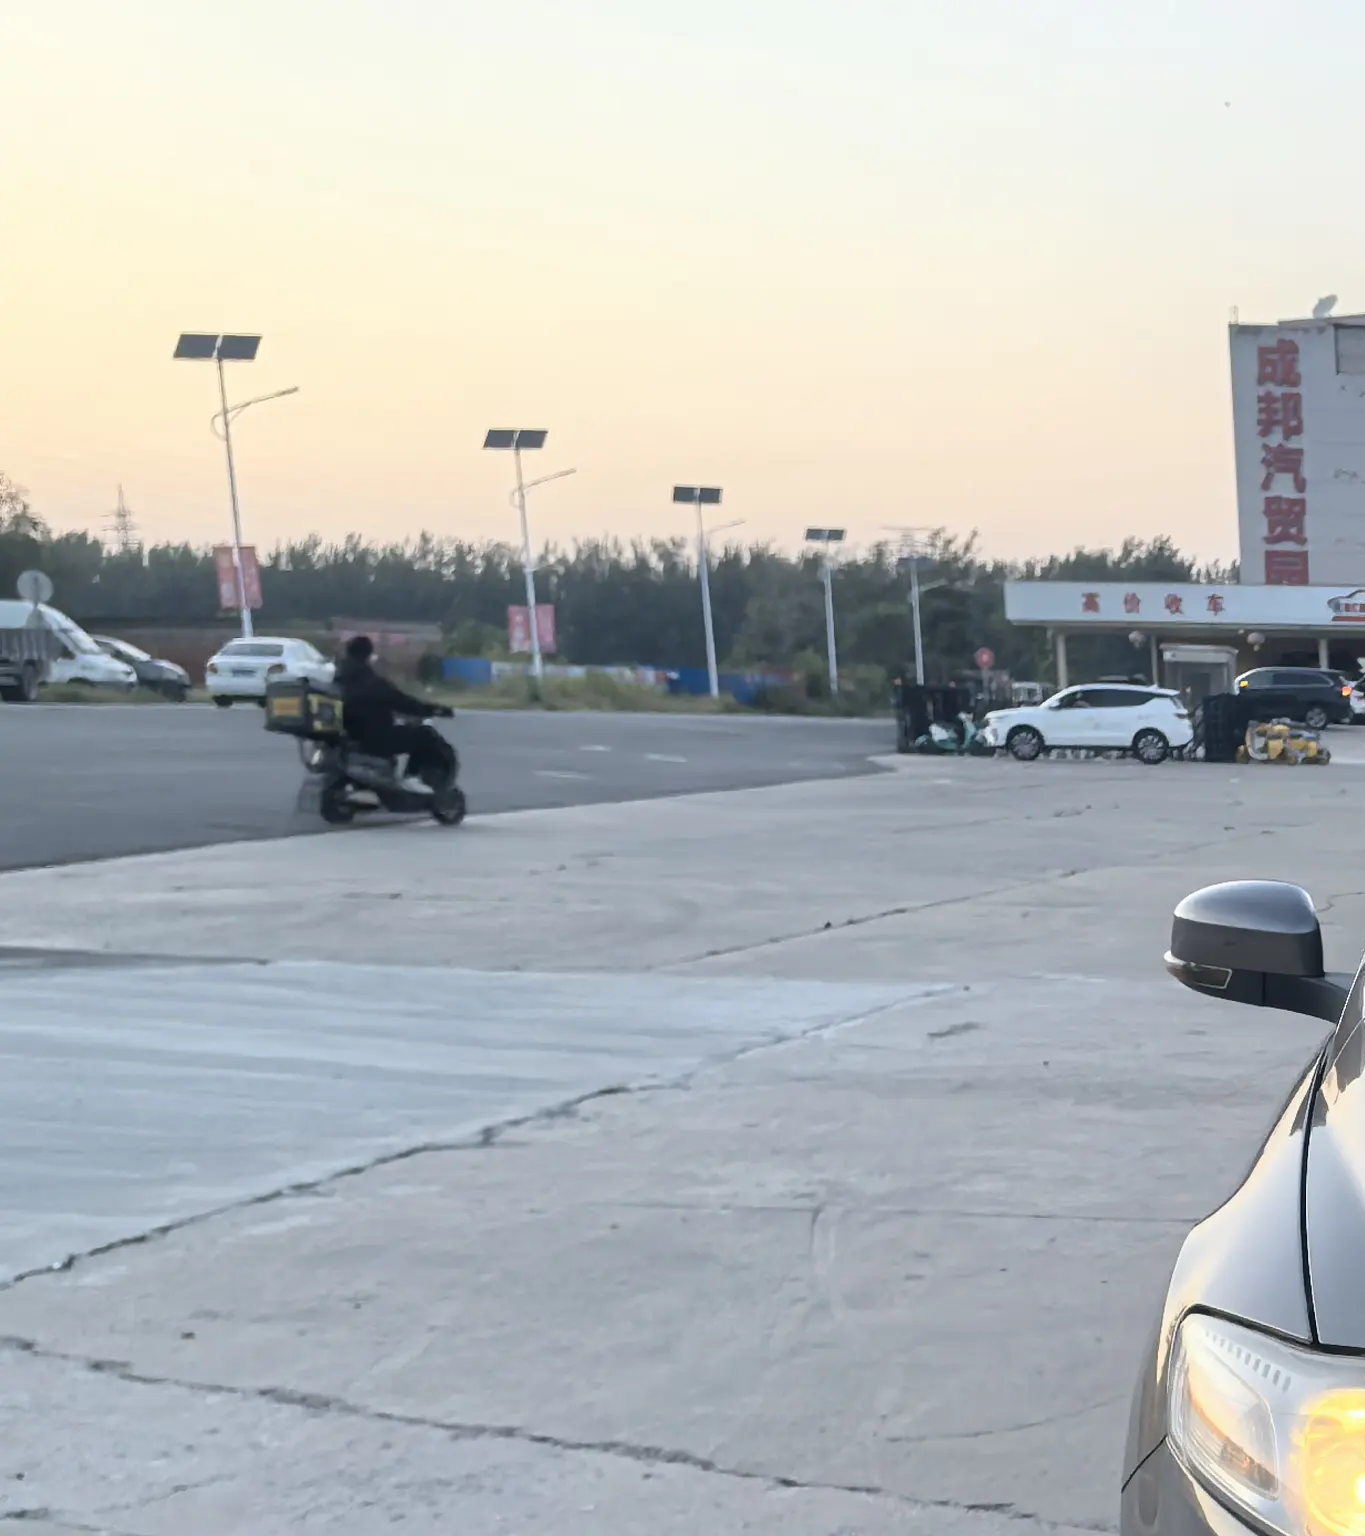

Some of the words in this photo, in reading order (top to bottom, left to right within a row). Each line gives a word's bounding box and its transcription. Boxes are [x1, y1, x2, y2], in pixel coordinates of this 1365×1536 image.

[1257, 338, 1310, 585] 成邦汽贸园
